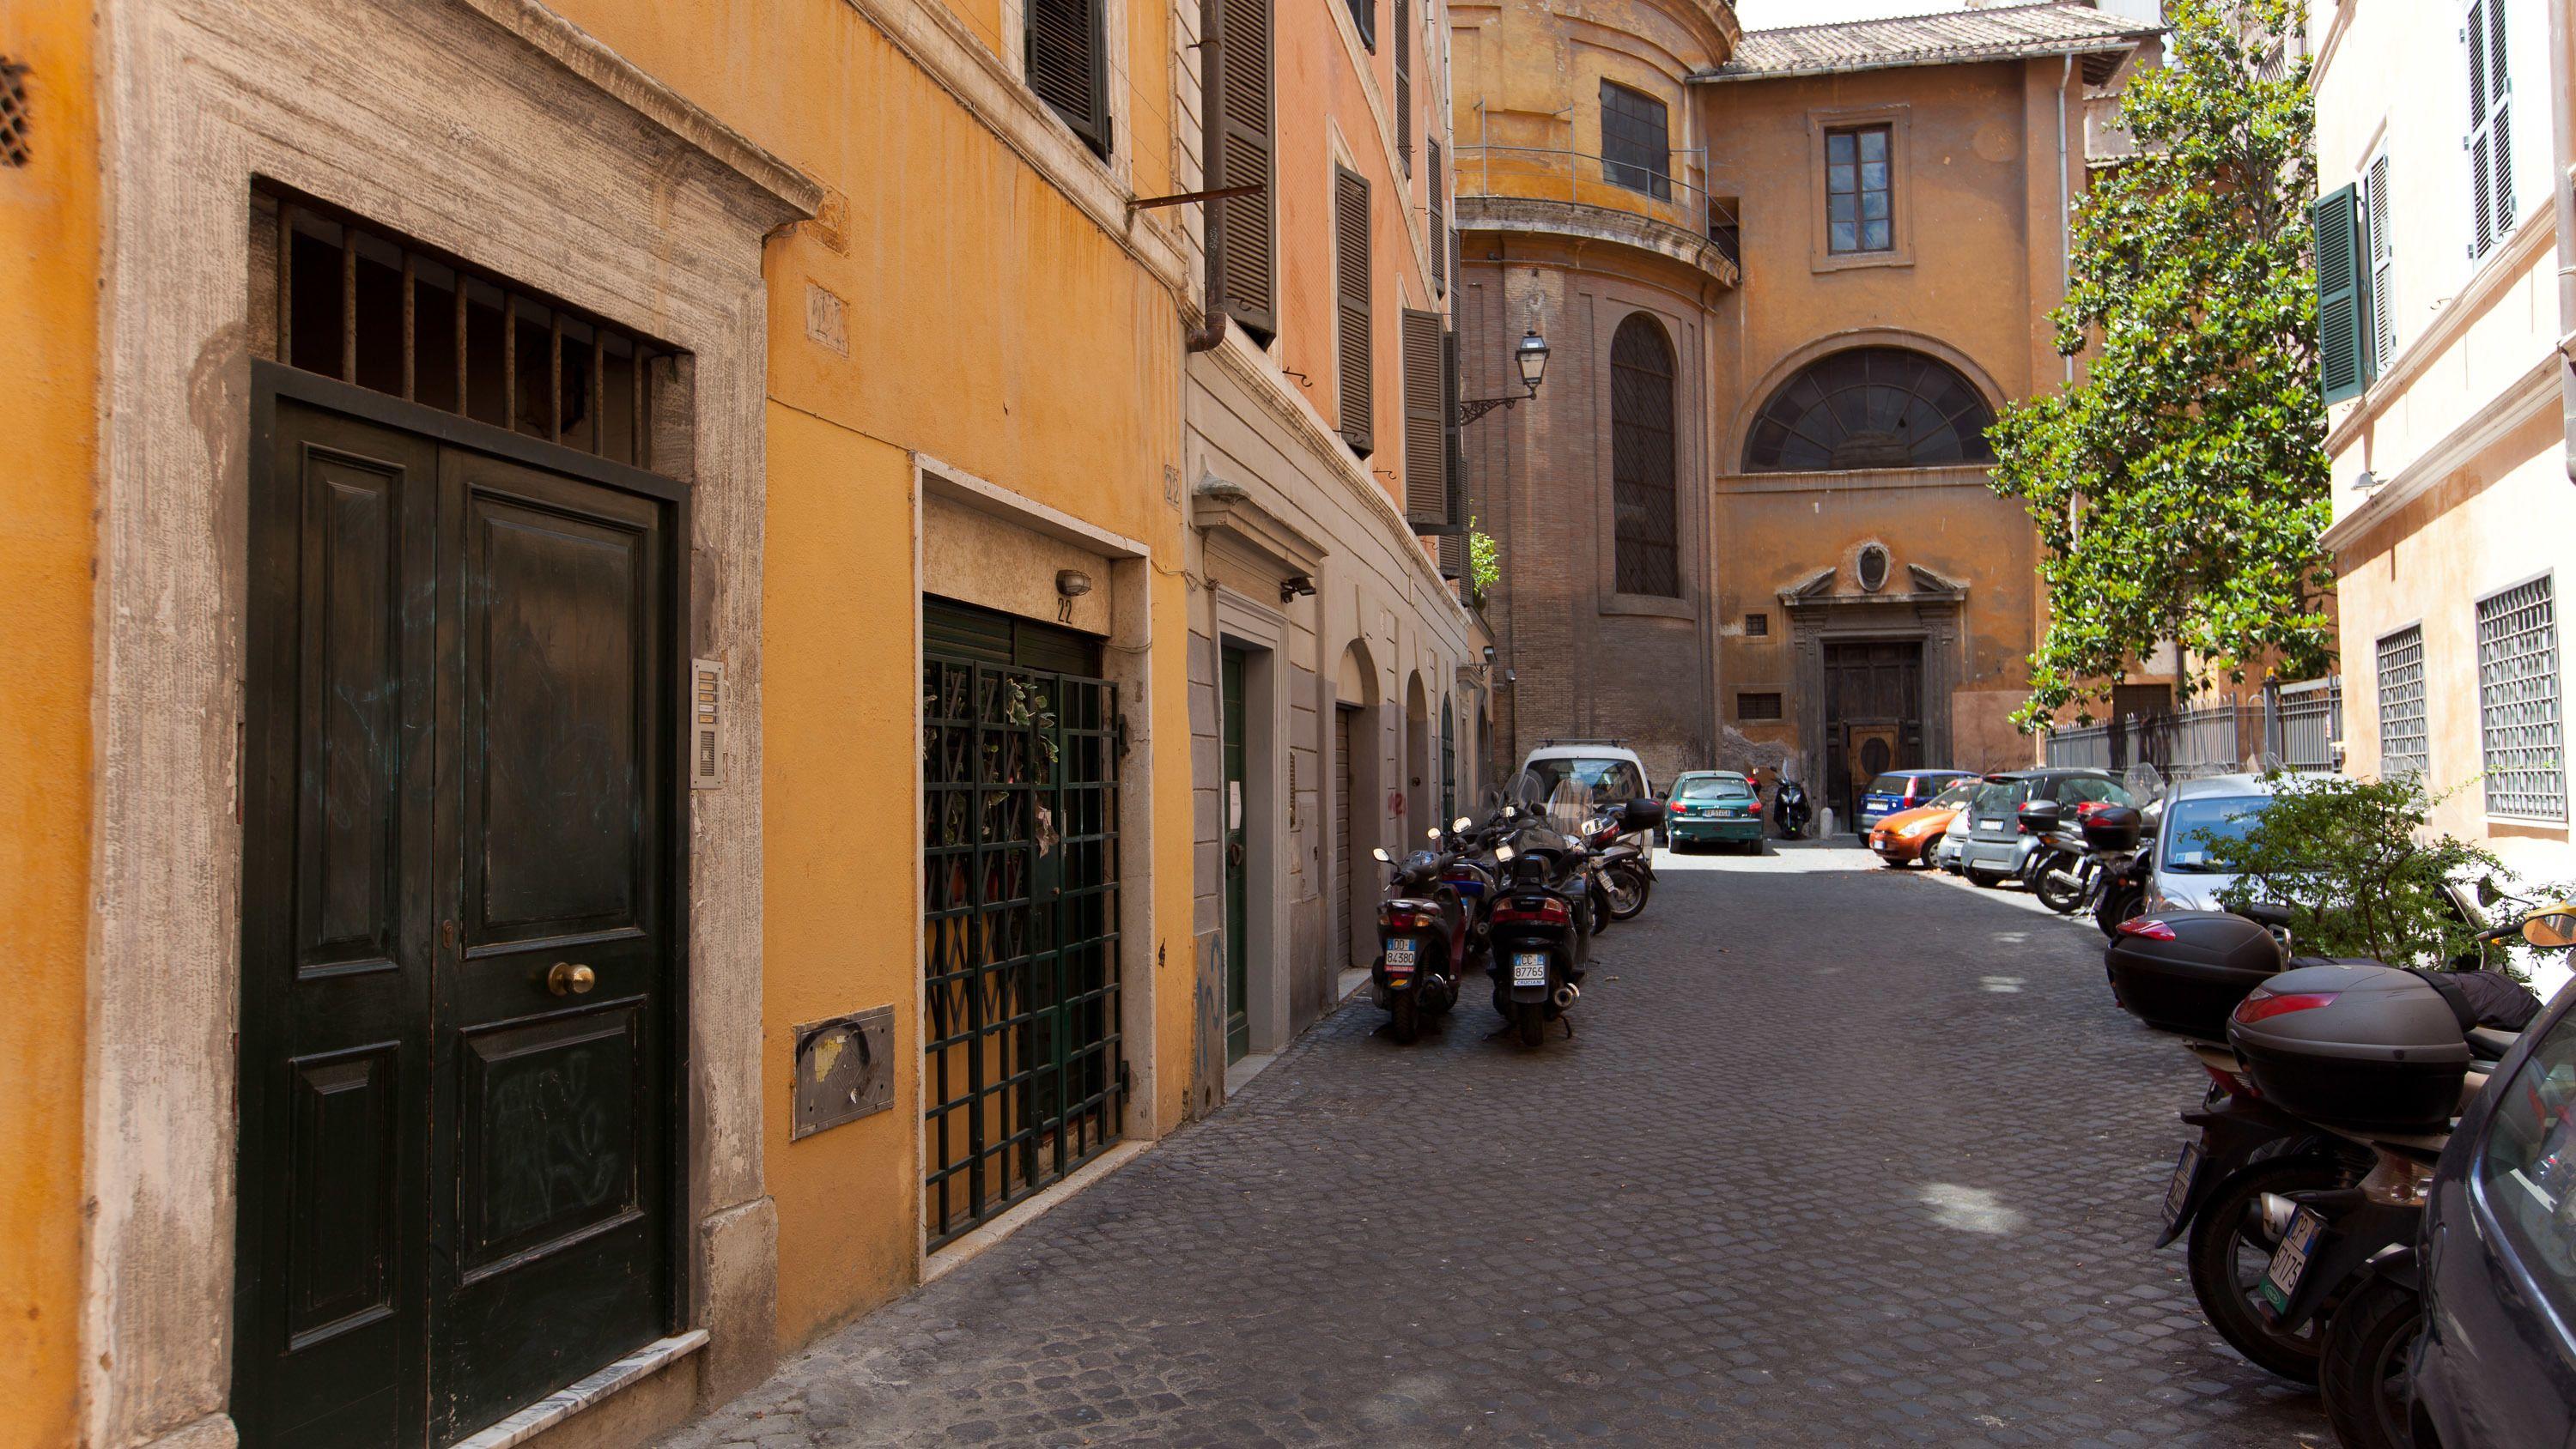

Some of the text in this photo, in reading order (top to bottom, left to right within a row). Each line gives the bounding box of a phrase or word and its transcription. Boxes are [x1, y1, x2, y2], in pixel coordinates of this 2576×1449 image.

[1058, 597, 1072, 624] 22
[1387, 952, 1414, 963] 84380
[1521, 955, 1533, 966] CC
[1515, 967, 1544, 977] 87765
[2291, 1214, 2309, 1243] CP
[2271, 1245, 2303, 1288] 57175
